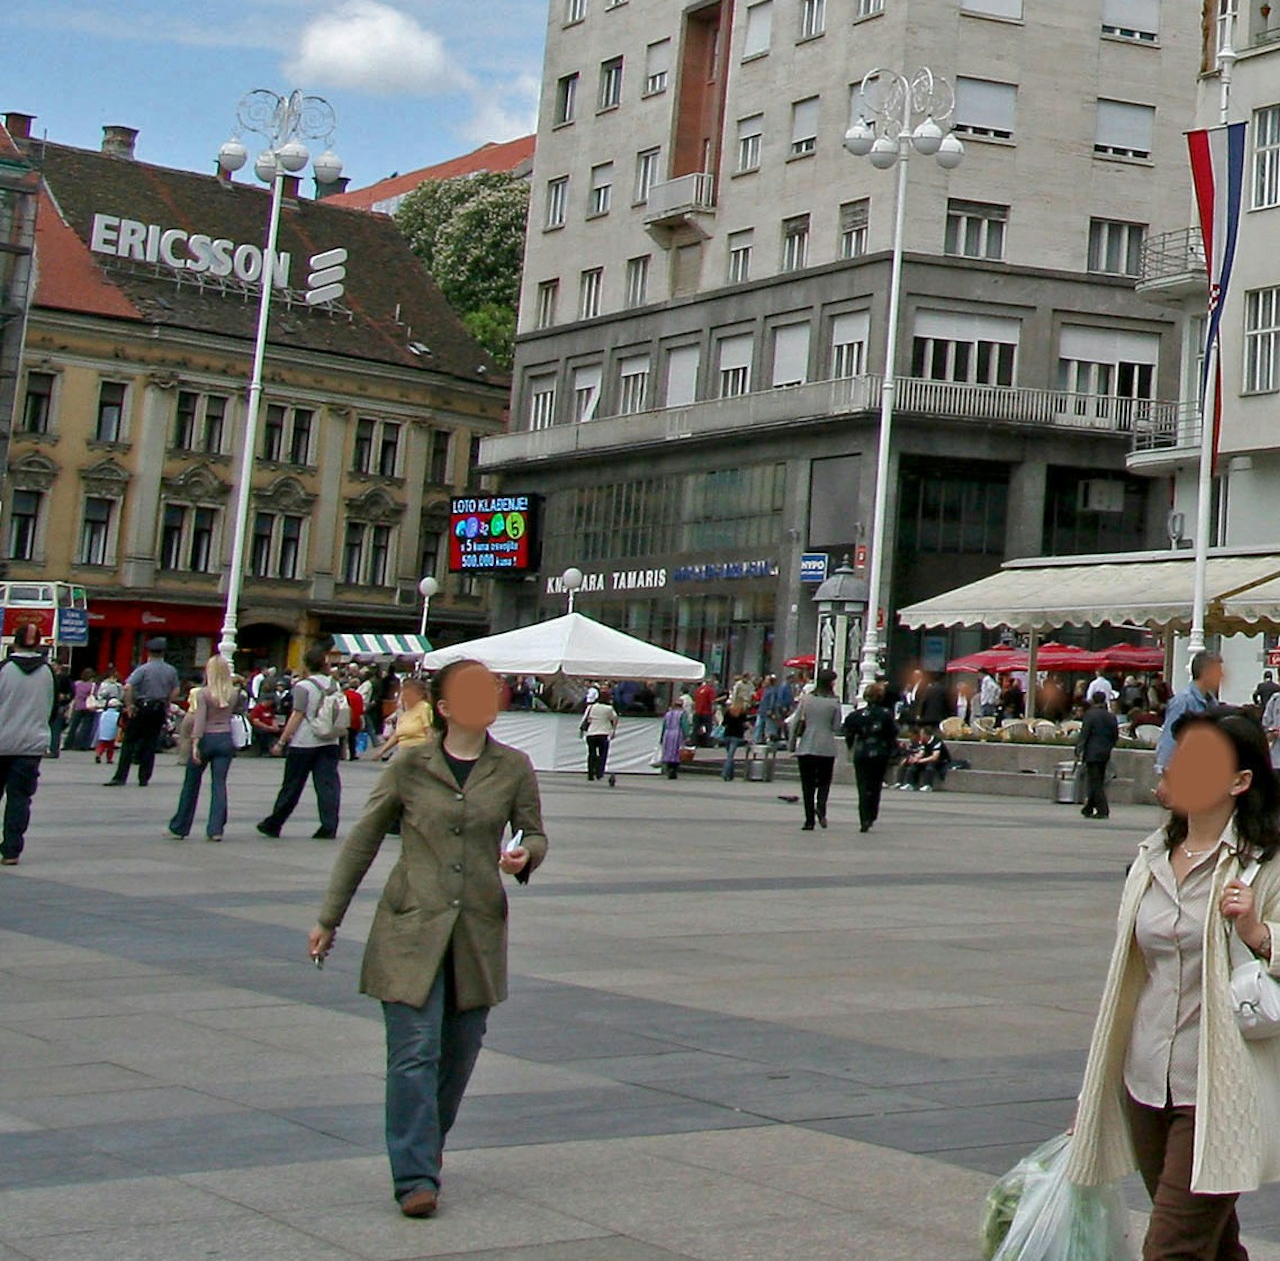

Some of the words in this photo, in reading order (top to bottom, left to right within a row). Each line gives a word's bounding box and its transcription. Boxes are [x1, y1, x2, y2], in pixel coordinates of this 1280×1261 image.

[91, 213, 290, 288] ERICSSON
[452, 499, 476, 513] LOTO
[466, 539, 472, 551] 5
[547, 573, 604, 594] KNARA
[612, 568, 667, 590] TAMARIS
